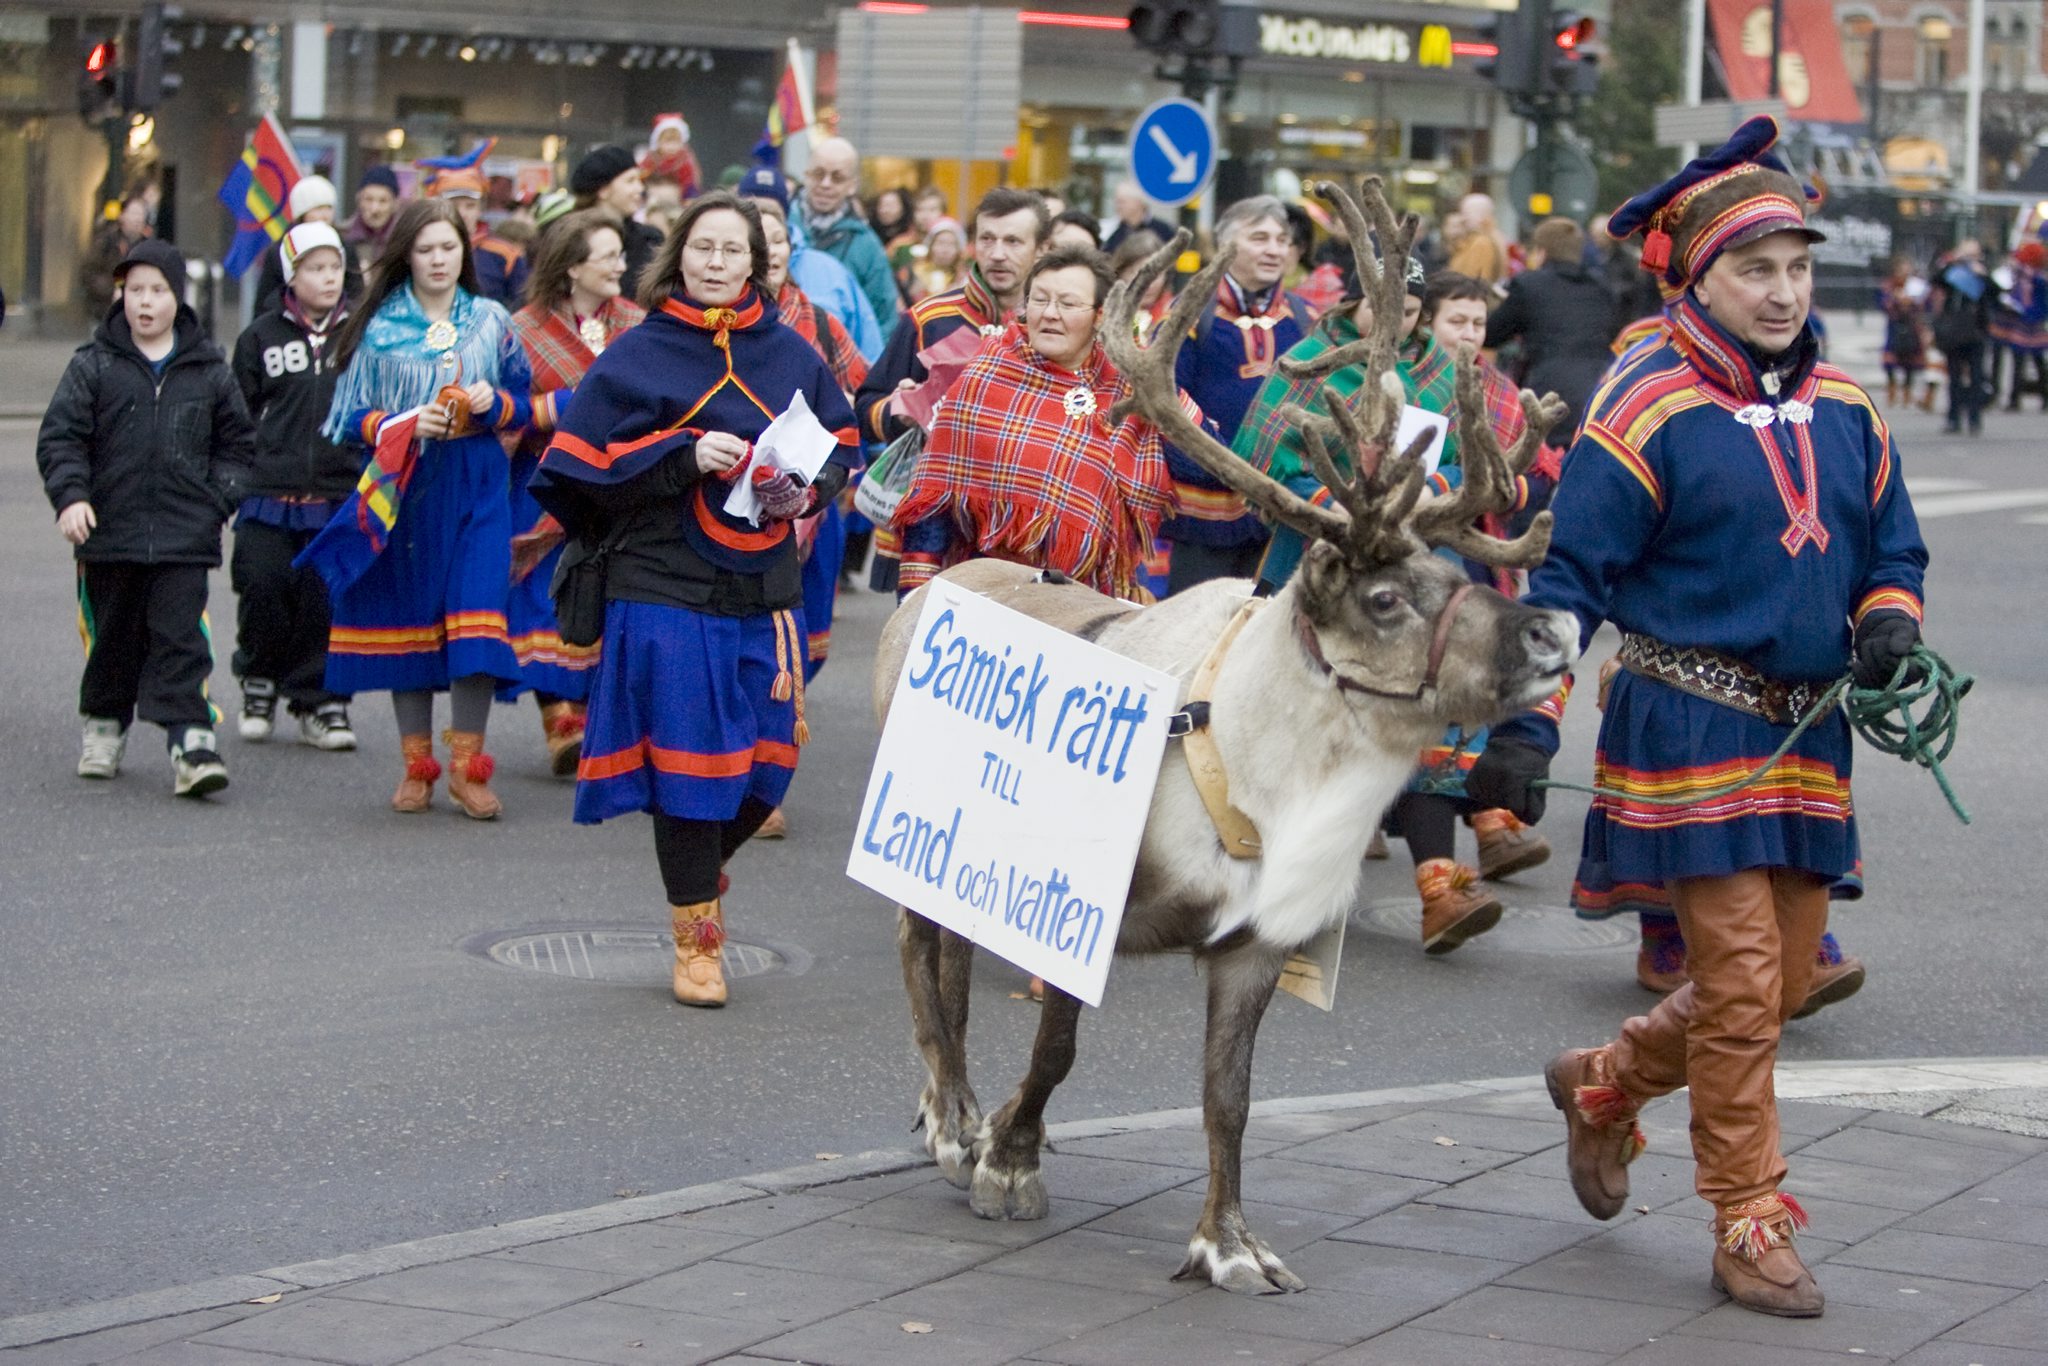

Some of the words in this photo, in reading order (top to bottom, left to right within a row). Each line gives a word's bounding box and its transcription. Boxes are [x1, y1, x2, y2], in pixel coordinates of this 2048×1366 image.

[263, 340, 309, 377] 88
[909, 609, 1049, 744] Samisk
[1047, 681, 1148, 783] rätt
[980, 750, 1021, 806] TILL
[862, 770, 962, 889] Land
[955, 859, 999, 916] och
